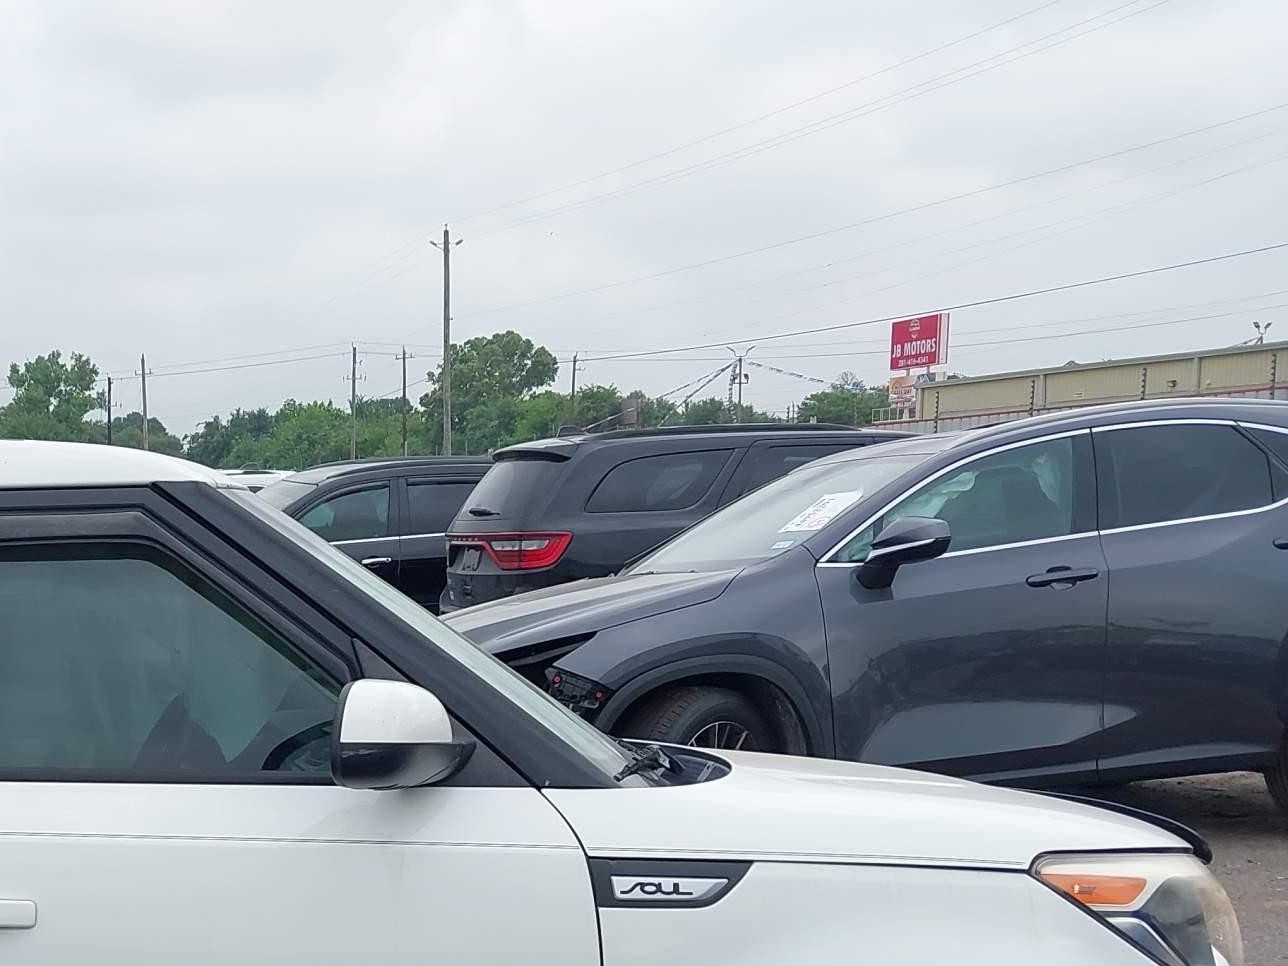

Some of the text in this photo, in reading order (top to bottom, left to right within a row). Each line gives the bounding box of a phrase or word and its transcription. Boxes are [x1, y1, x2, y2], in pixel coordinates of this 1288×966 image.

[892, 338, 936, 358] JB MOTORS
[619, 881, 694, 896] SOUL
